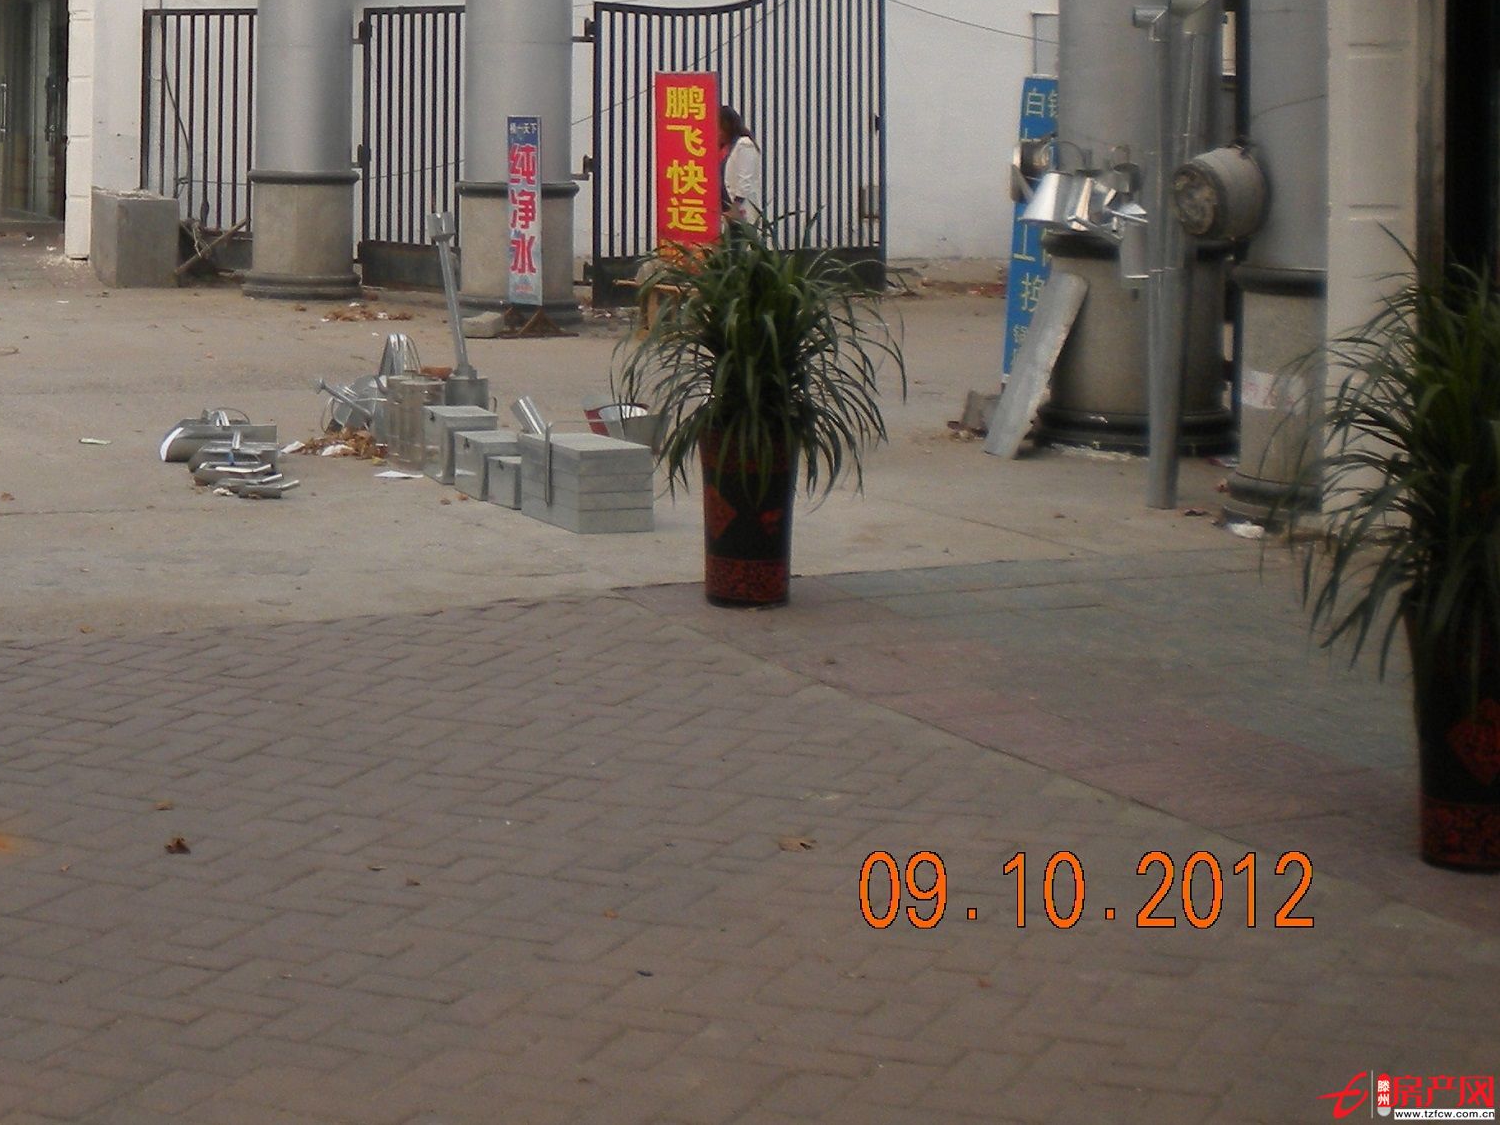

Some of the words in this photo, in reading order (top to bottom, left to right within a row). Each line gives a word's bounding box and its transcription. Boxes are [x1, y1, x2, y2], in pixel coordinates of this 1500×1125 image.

[508, 142, 537, 274] 纯净水
[664, 85, 709, 233] 鹏飞快运
